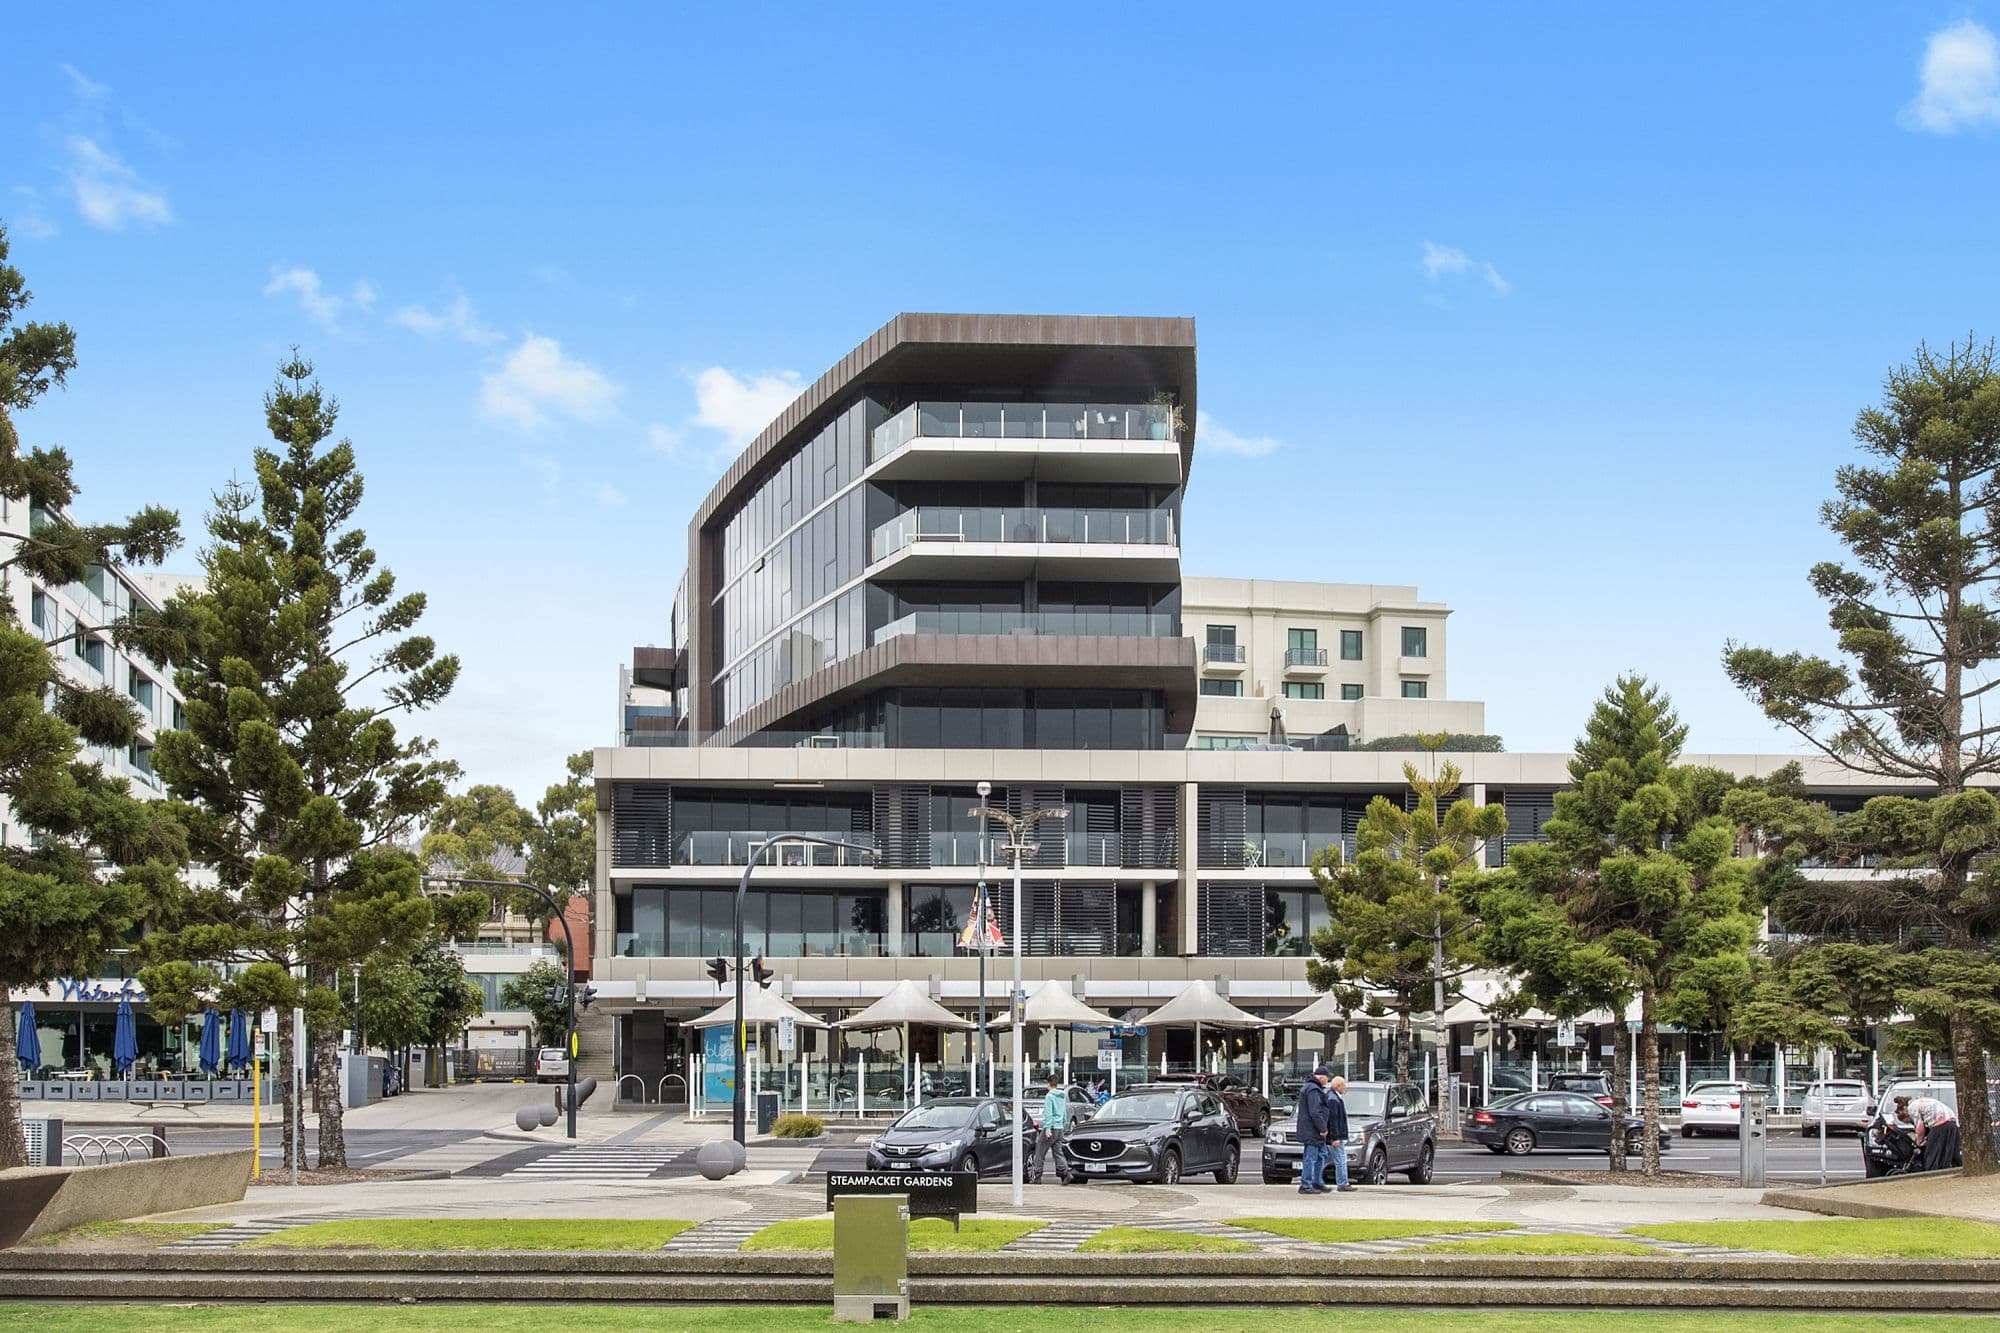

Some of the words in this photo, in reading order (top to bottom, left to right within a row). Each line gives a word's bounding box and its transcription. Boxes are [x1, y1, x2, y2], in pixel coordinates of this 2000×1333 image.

[58, 976, 149, 1001] Waterfro
[830, 1175, 901, 1186] STEAMPACKET
[903, 1176, 953, 1187] GARDENS
